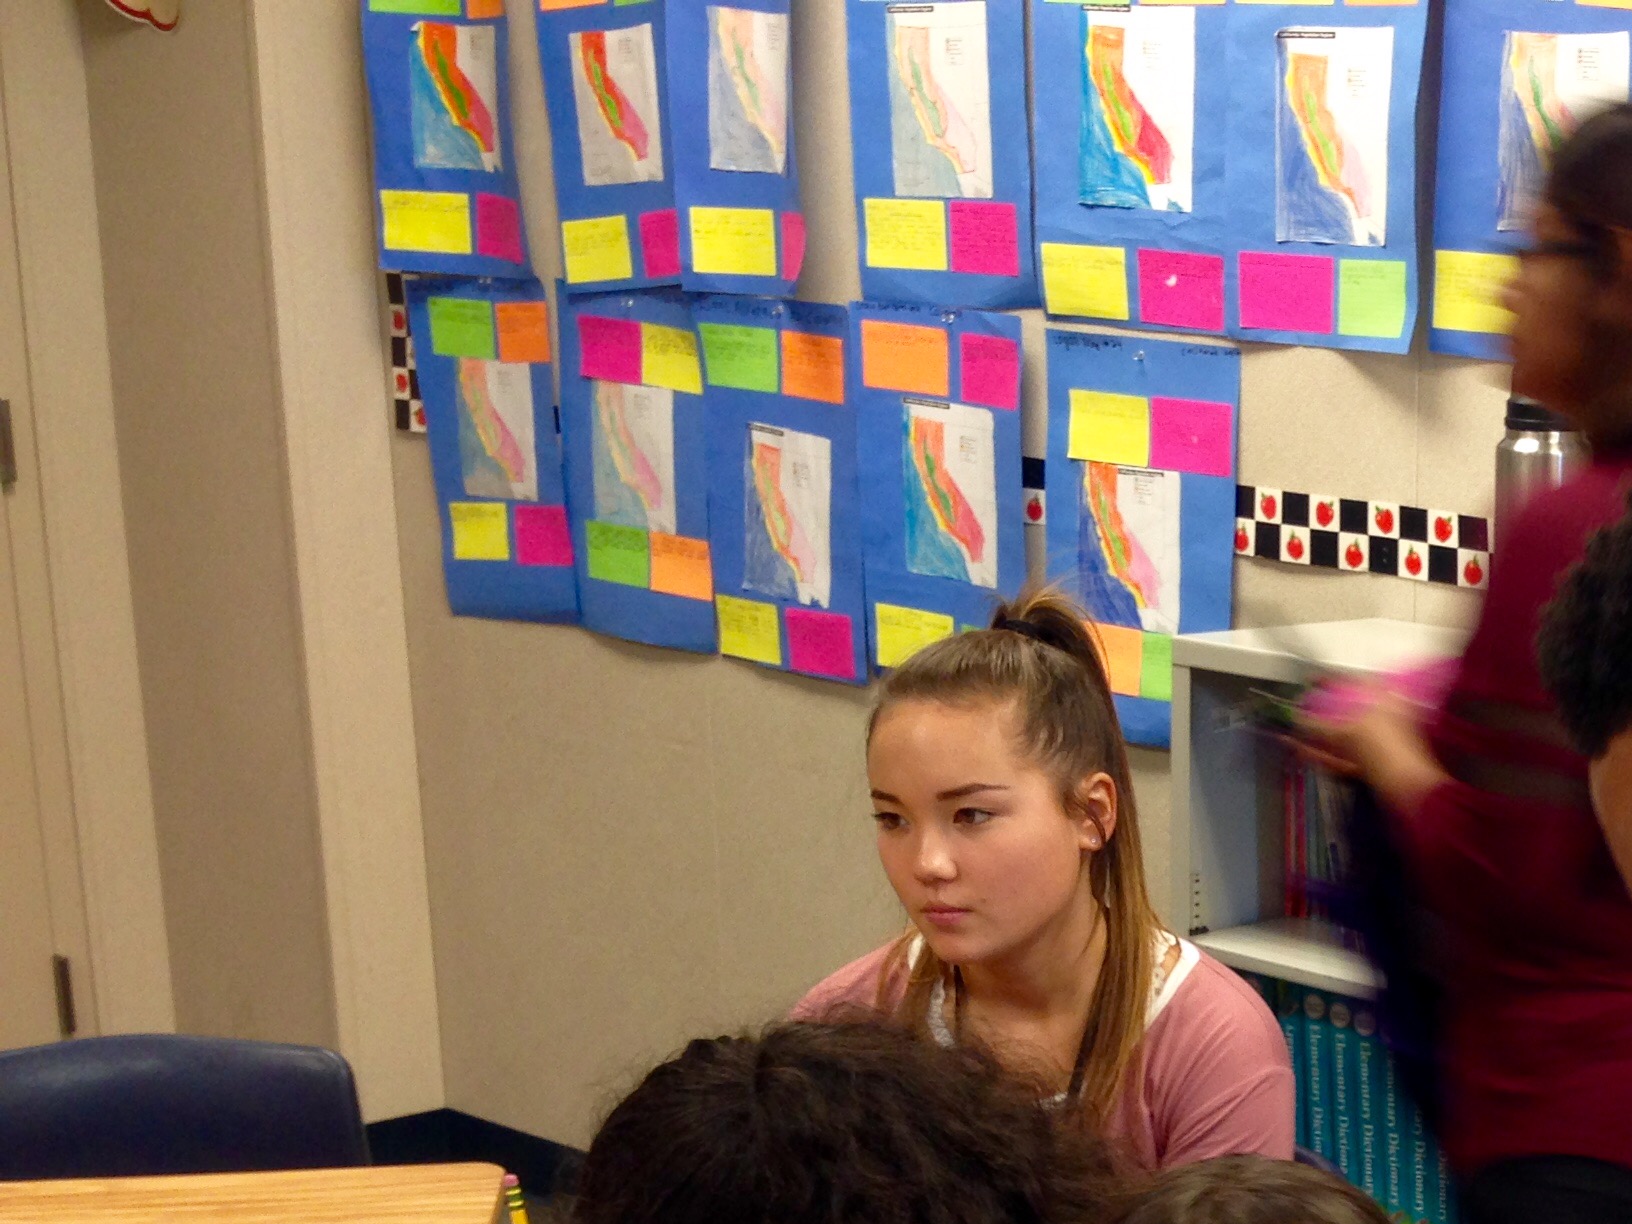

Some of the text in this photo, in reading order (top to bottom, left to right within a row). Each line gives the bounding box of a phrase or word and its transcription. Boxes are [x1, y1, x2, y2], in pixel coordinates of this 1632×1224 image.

[1309, 1024, 1322, 1102] Elementary
[1359, 1041, 1372, 1120] Elementary
[1335, 1033, 1350, 1175] Elementary Dictiona
[1388, 1132, 1401, 1206] Dictionary
[1414, 1140, 1428, 1213] Dictionary
